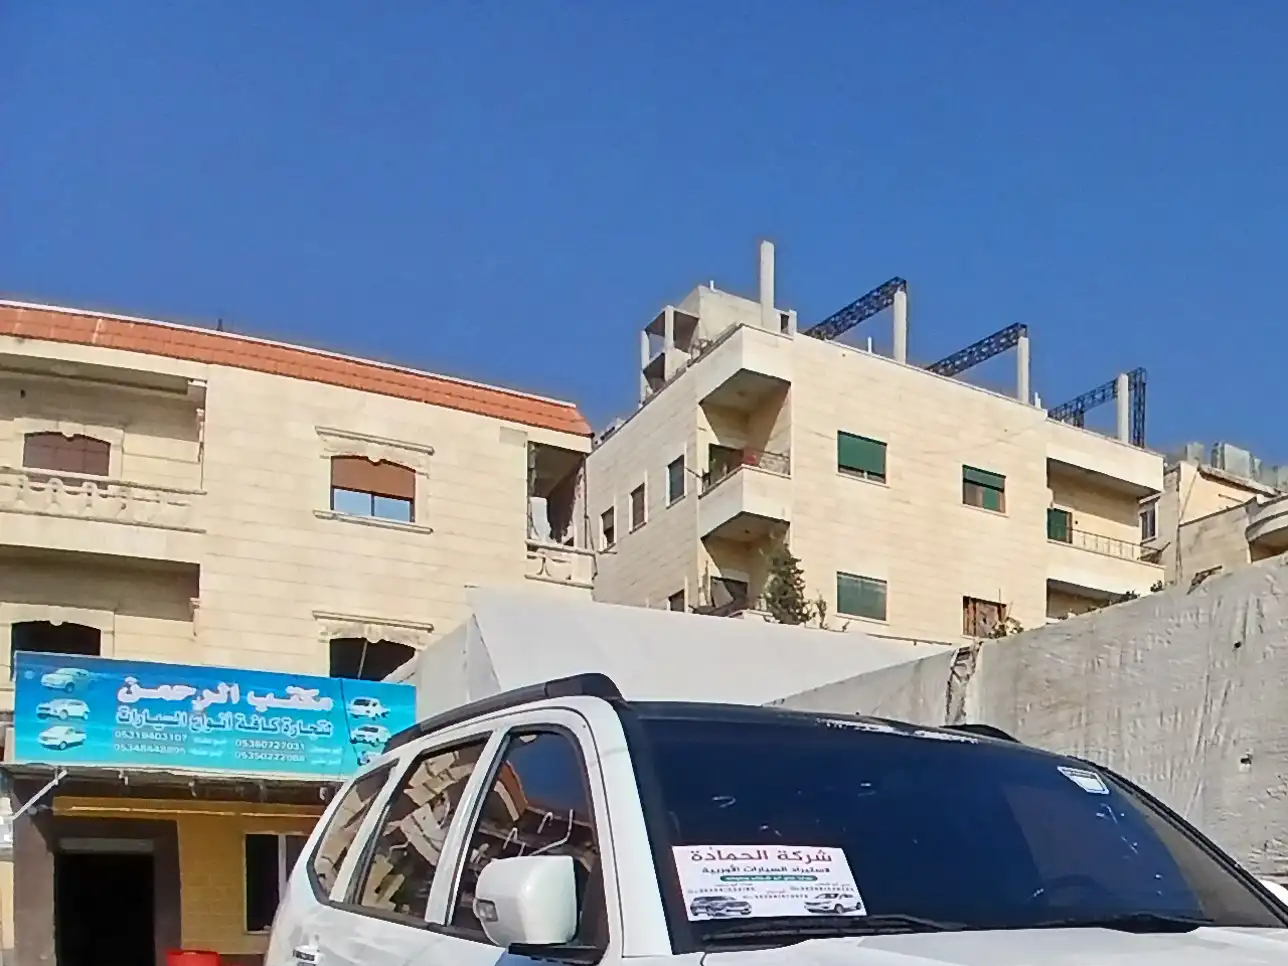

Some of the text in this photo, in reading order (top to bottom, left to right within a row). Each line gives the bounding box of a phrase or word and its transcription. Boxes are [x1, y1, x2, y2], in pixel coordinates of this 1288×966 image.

[117, 676, 334, 712] مكتب الرحمن
[115, 706, 187, 730] السيارات
[190, 711, 234, 733] أنواع
[235, 712, 281, 735] كافة
[777, 849, 833, 864] شركة
[743, 865, 788, 873] السيارات
